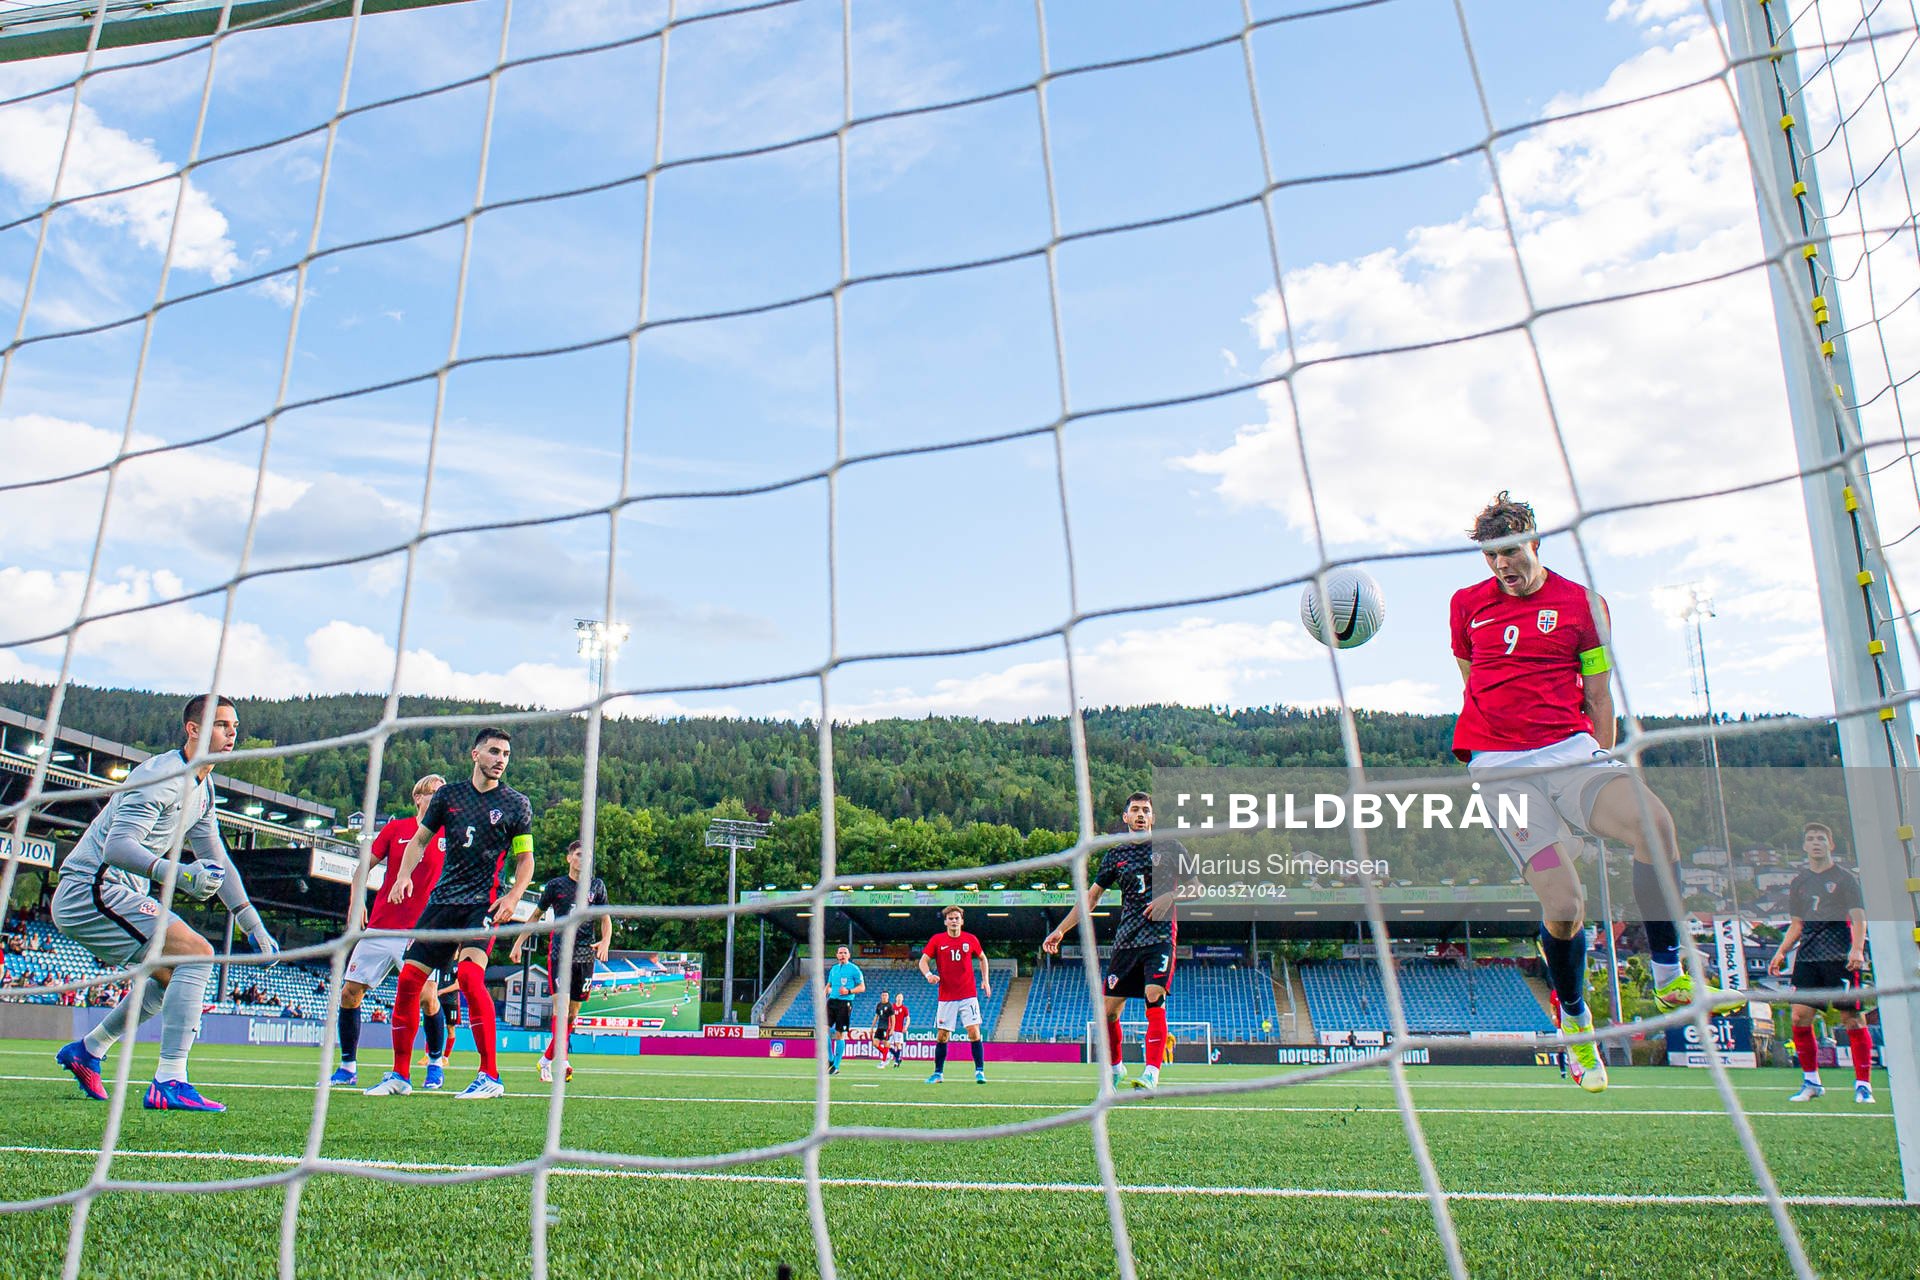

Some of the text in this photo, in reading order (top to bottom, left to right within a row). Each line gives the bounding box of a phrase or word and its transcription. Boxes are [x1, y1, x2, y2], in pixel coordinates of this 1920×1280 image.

[1503, 625, 1520, 655] 9
[462, 826, 476, 848] 5
[1812, 895, 1820, 911] 7
[950, 949, 961, 961] 16
[1158, 953, 1169, 972] 3
[451, 1010, 457, 1020] 11
[248, 1019, 286, 1044] Equinor
[707, 1027, 741, 1038] RVS AS
[1683, 1020, 1736, 1043] ecit
